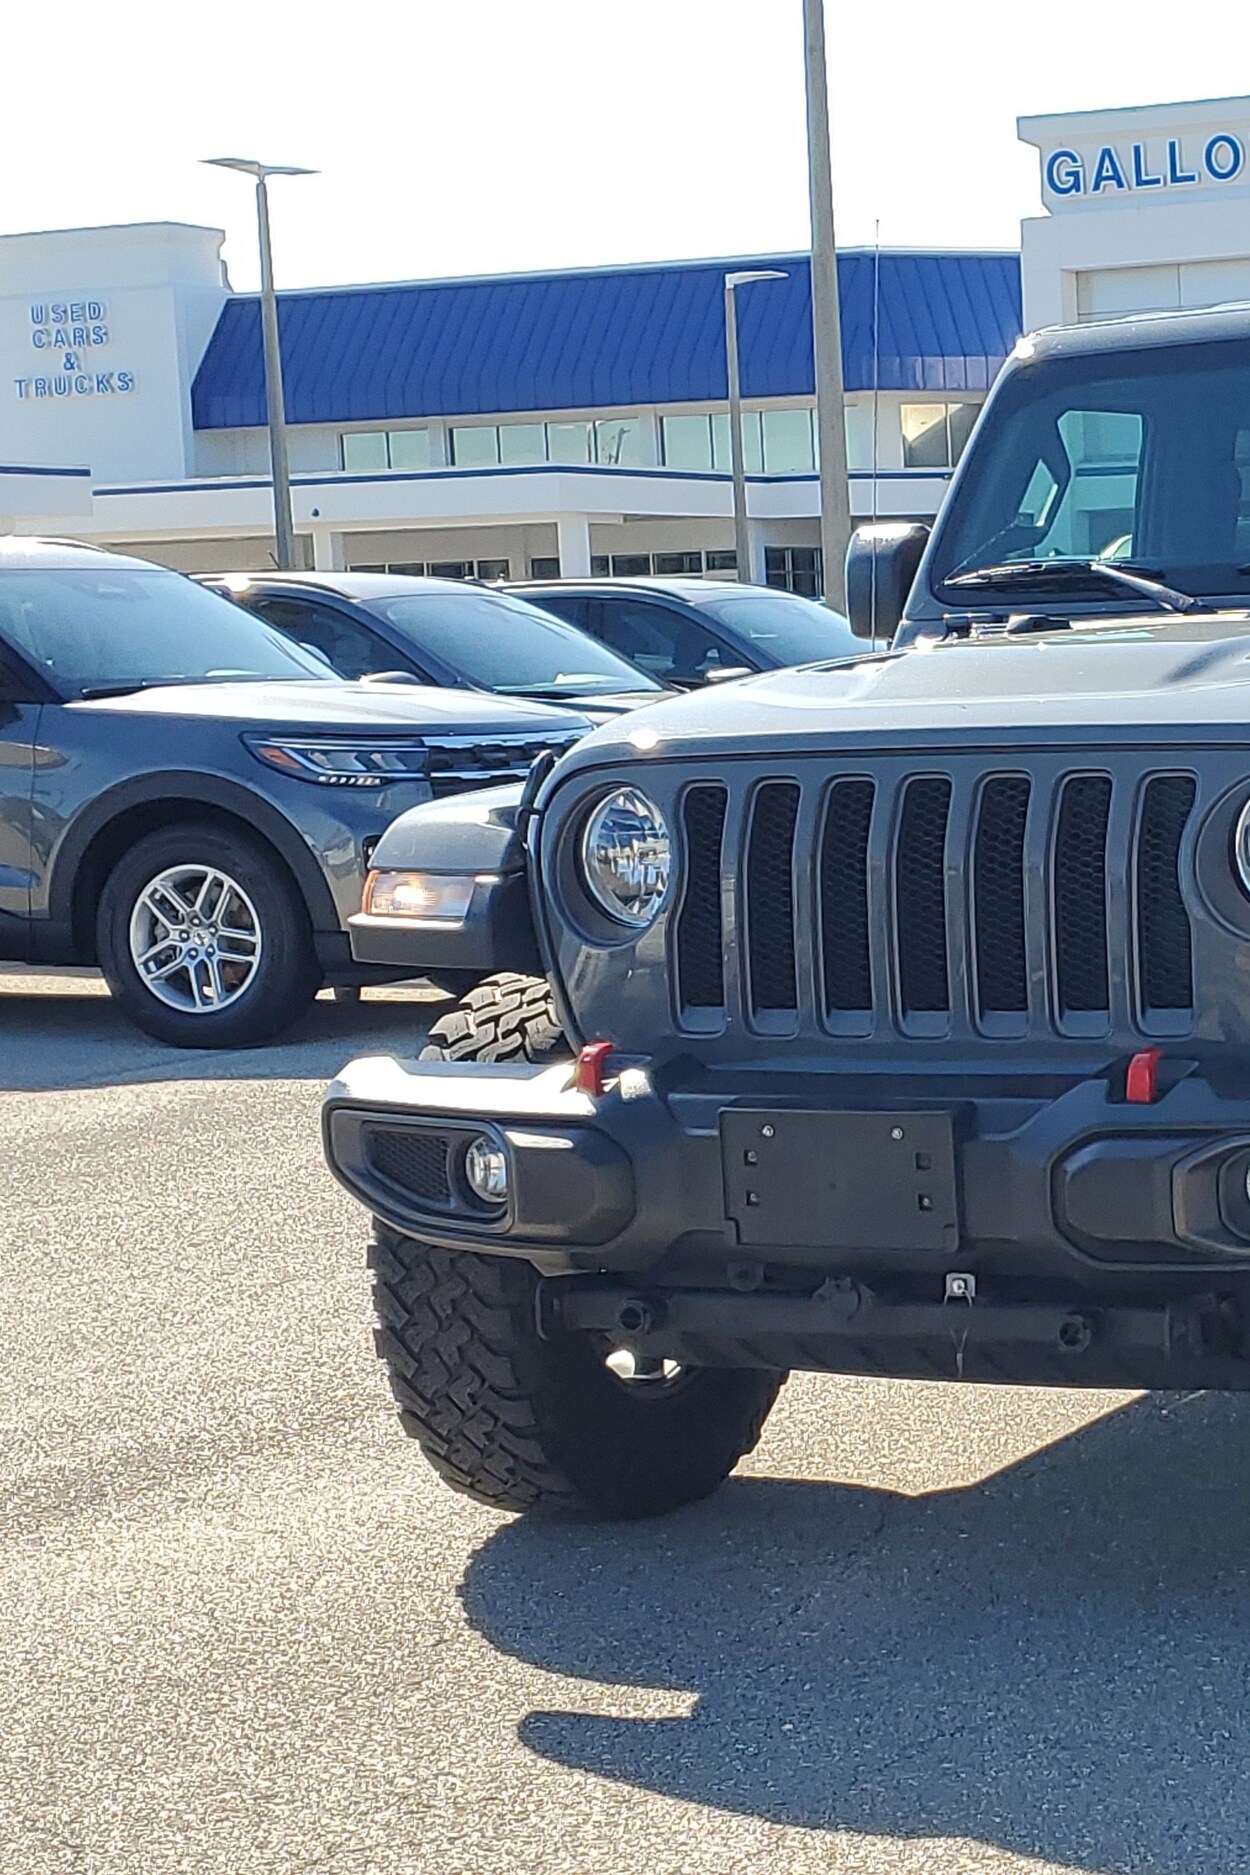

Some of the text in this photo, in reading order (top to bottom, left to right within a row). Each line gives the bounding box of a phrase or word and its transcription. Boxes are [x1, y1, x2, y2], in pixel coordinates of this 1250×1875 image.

[31, 301, 102, 324] USED
[32, 325, 107, 349] CARS
[63, 352, 77, 371] &
[15, 372, 133, 398] TRUCKS
